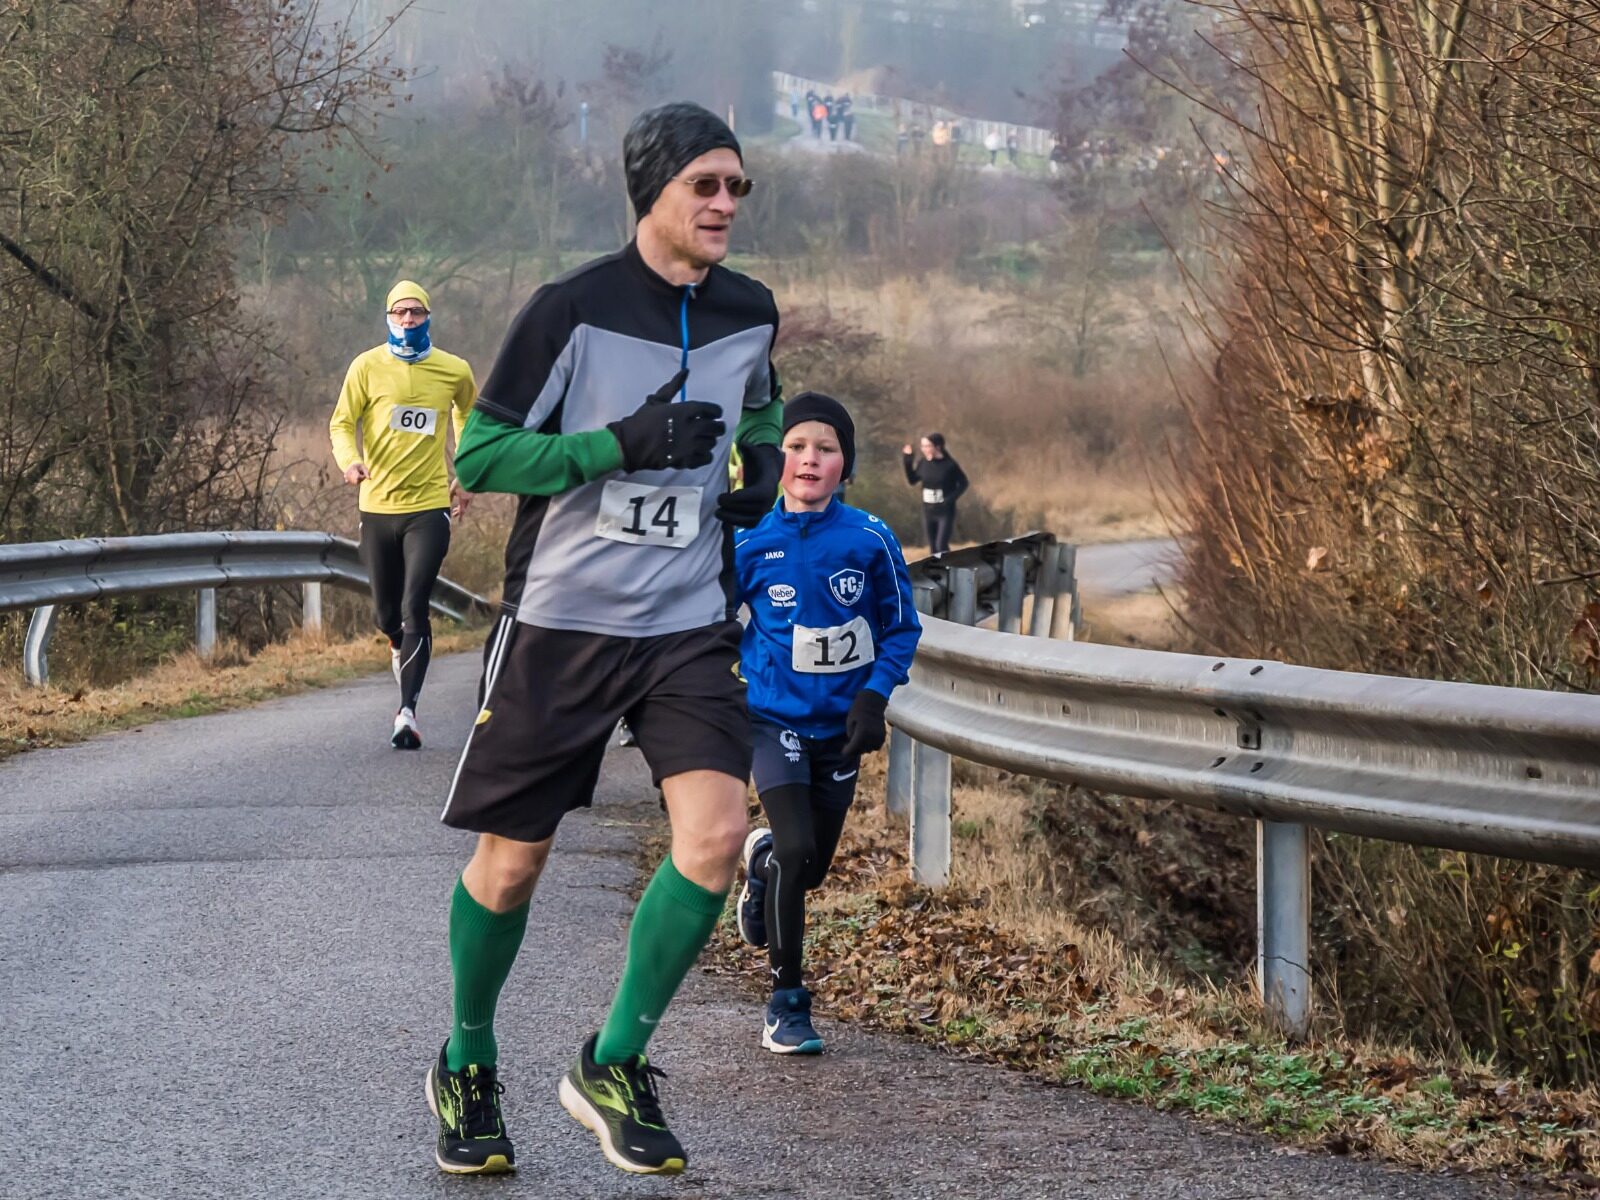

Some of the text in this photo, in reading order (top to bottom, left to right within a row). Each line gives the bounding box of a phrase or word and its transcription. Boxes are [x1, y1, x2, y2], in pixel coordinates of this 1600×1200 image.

[401, 410, 428, 430] 60
[622, 496, 679, 538] 14
[764, 550, 785, 560] JAKO
[839, 576, 857, 595] FC
[814, 630, 860, 666] 12
